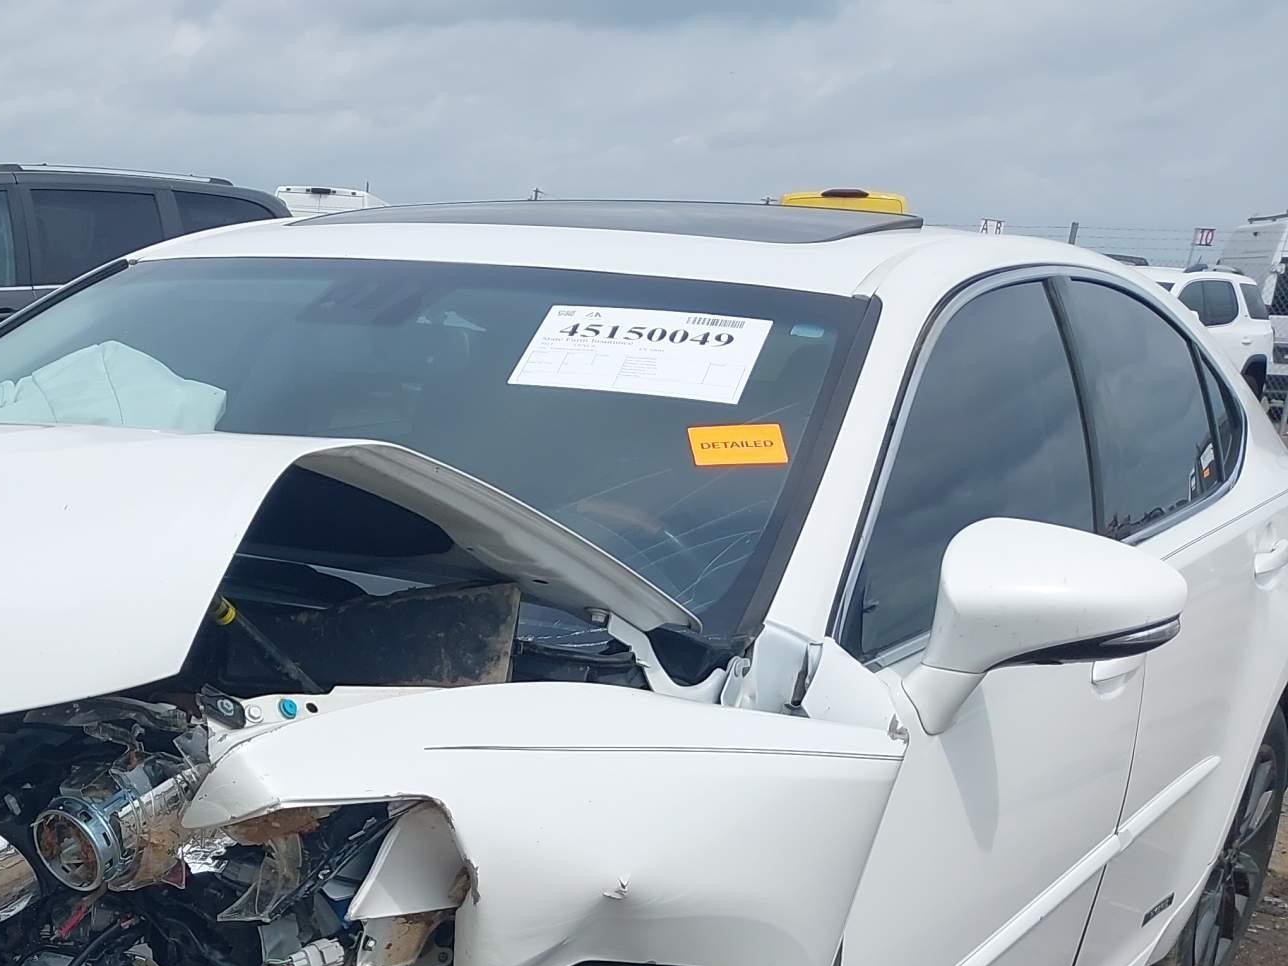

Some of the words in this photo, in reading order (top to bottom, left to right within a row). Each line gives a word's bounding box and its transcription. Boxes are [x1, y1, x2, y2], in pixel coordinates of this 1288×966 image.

[1199, 229, 1214, 246] 10
[560, 323, 735, 347] 45150049
[700, 440, 774, 450] DETAILED
